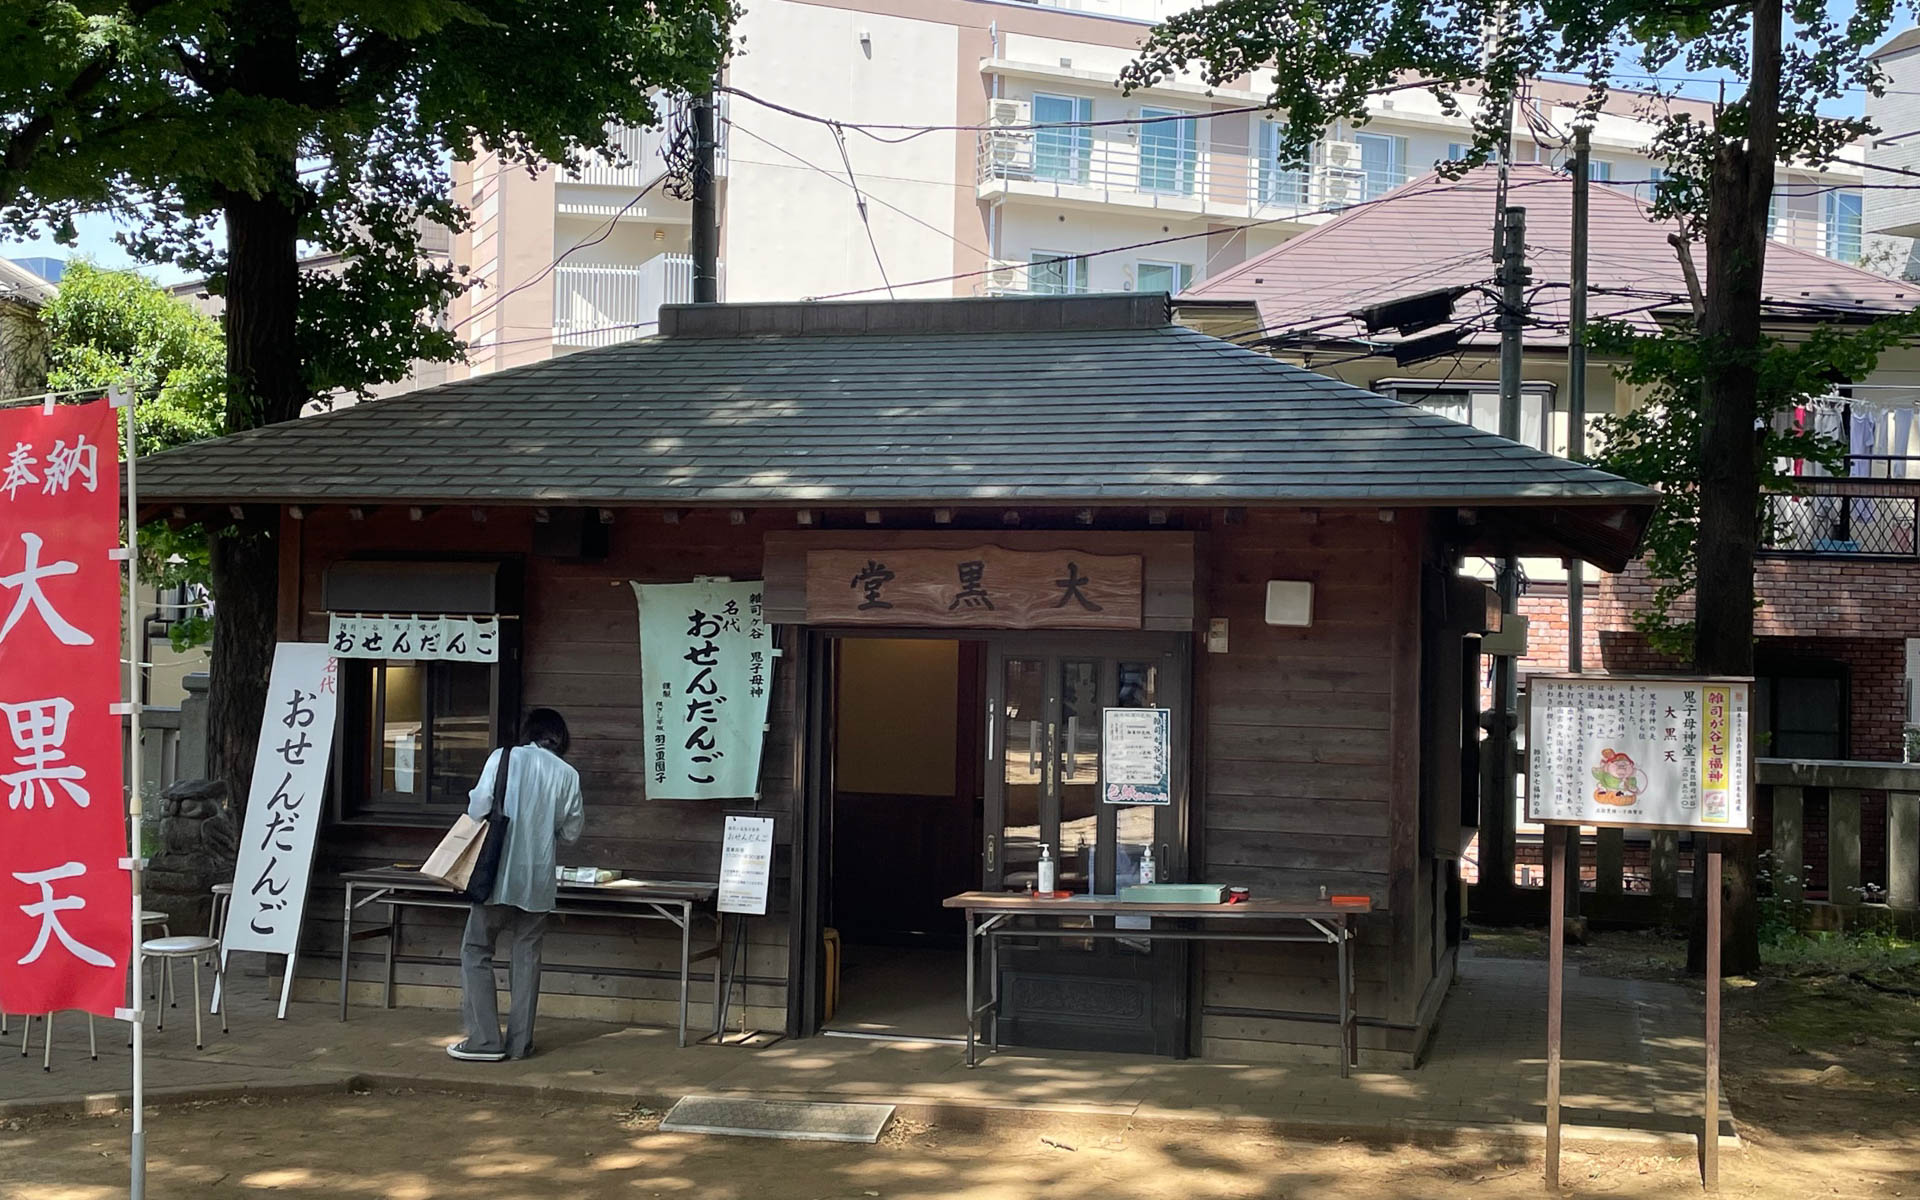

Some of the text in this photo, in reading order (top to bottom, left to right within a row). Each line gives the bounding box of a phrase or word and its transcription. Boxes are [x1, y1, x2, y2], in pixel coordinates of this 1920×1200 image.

[1, 433, 98, 499] 奉納
[850, 560, 1104, 612] 大黒堂
[334, 630, 497, 655] おせんだんご
[722, 600, 741, 633] 名代
[321, 657, 336, 694] 名代
[683, 609, 727, 784] おせんだんご
[749, 652, 764, 698] 鬼子母神
[0, 532, 116, 968] 大黒天
[1664, 706, 1677, 762] 大黒天
[1682, 691, 1697, 757] 鬼子母神堂
[1708, 692, 1723, 783] 雑司が谷七福神
[250, 690, 315, 935] おせんだんご
[728, 833, 768, 842] おせんだんご
